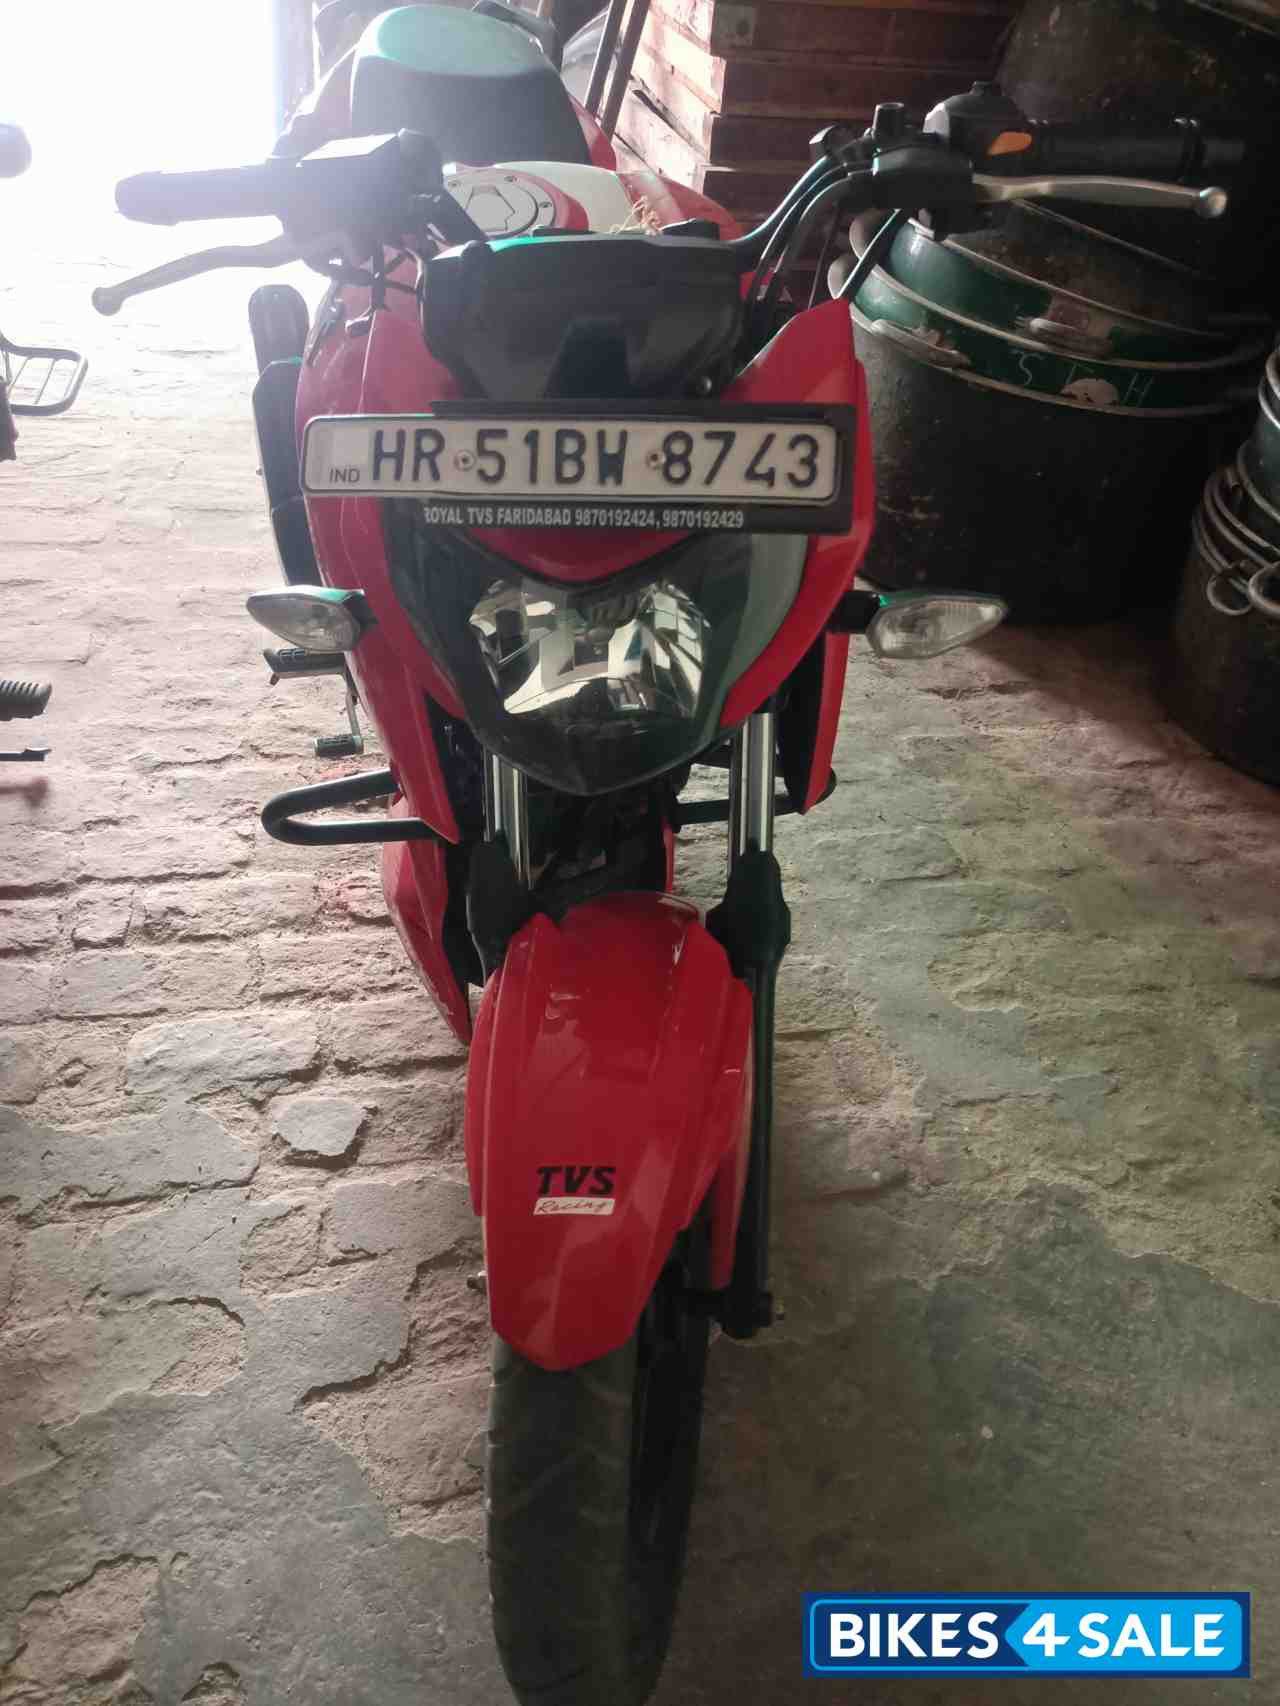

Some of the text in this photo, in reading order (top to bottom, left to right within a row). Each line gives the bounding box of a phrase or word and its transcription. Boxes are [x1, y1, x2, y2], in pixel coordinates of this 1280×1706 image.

[372, 428, 820, 488] HR 51BW 8743
[328, 466, 360, 484] IND
[467, 507, 494, 525] TVS
[497, 508, 571, 526] FARIDABAD
[662, 510, 744, 528] 9870192429
[537, 1166, 616, 1195] TVS
